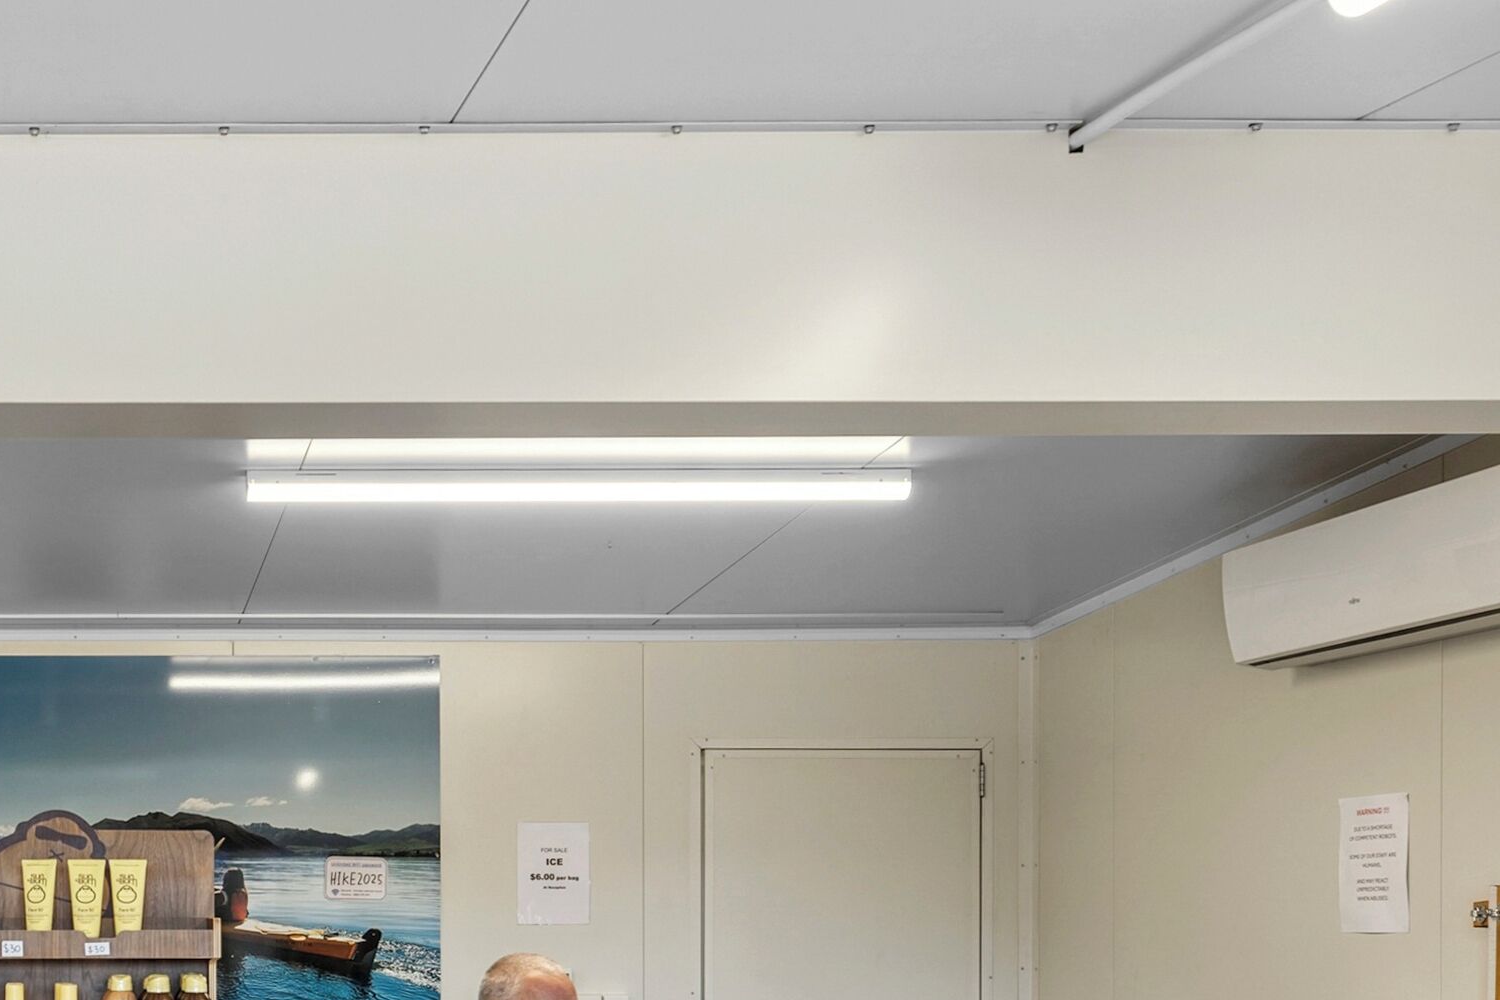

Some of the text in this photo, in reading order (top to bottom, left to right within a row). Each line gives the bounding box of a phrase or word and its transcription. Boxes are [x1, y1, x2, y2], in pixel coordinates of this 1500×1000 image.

[1357, 807, 1382, 816] WARNING
[546, 858, 563, 866] ICE
[530, 873, 555, 881] $6.00
[4, 943, 21, 953] $30
[88, 945, 105, 953] $30
